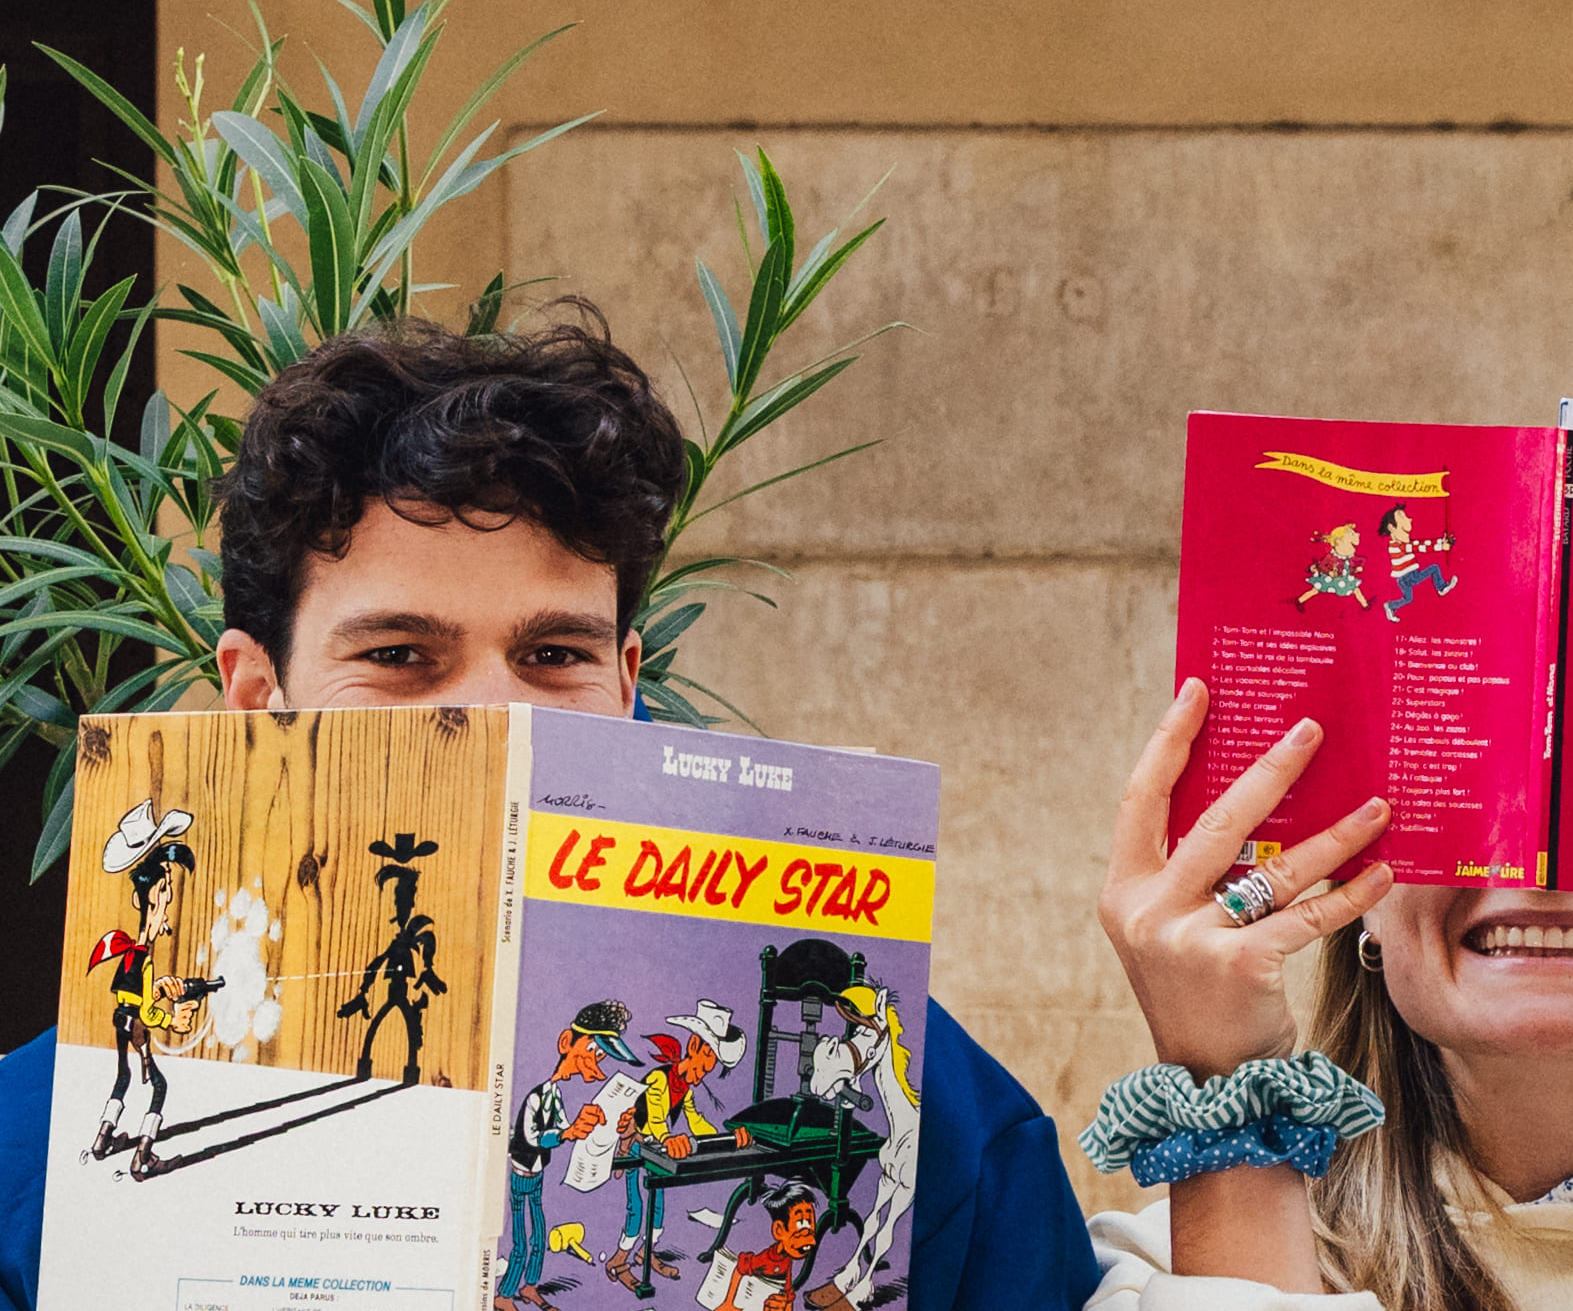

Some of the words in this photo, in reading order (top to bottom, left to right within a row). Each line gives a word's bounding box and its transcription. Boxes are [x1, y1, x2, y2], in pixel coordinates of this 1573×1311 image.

[1282, 455, 1315, 473] Dans
[1318, 467, 1331, 480] la
[1336, 474, 1373, 490] même
[1377, 479, 1439, 492] collection
[662, 746, 732, 783] LUCKY
[738, 756, 793, 791] LUKE
[797, 827, 842, 841] FAUCHE
[548, 829, 616, 892] LE
[624, 840, 768, 910] DAILY
[774, 858, 890, 926] STAR
[495, 1063, 505, 1090] STAR
[493, 1092, 504, 1122] DAILY
[492, 1124, 501, 1136] LE
[235, 1202, 341, 1218] LUCKY
[351, 1205, 440, 1220] LUKE
[233, 1226, 277, 1238] L'homme
[280, 1227, 296, 1240] qui
[299, 1229, 317, 1239] tire
[320, 1229, 341, 1242] plus
[344, 1230, 363, 1241] vite
[365, 1233, 383, 1245] que
[385, 1234, 402, 1242] son
[482, 1249, 491, 1278] MORRIS
[239, 1275, 270, 1287] DANS
[272, 1277, 285, 1288] LA
[288, 1277, 320, 1289] MEME
[322, 1278, 391, 1292] COLLECTION
